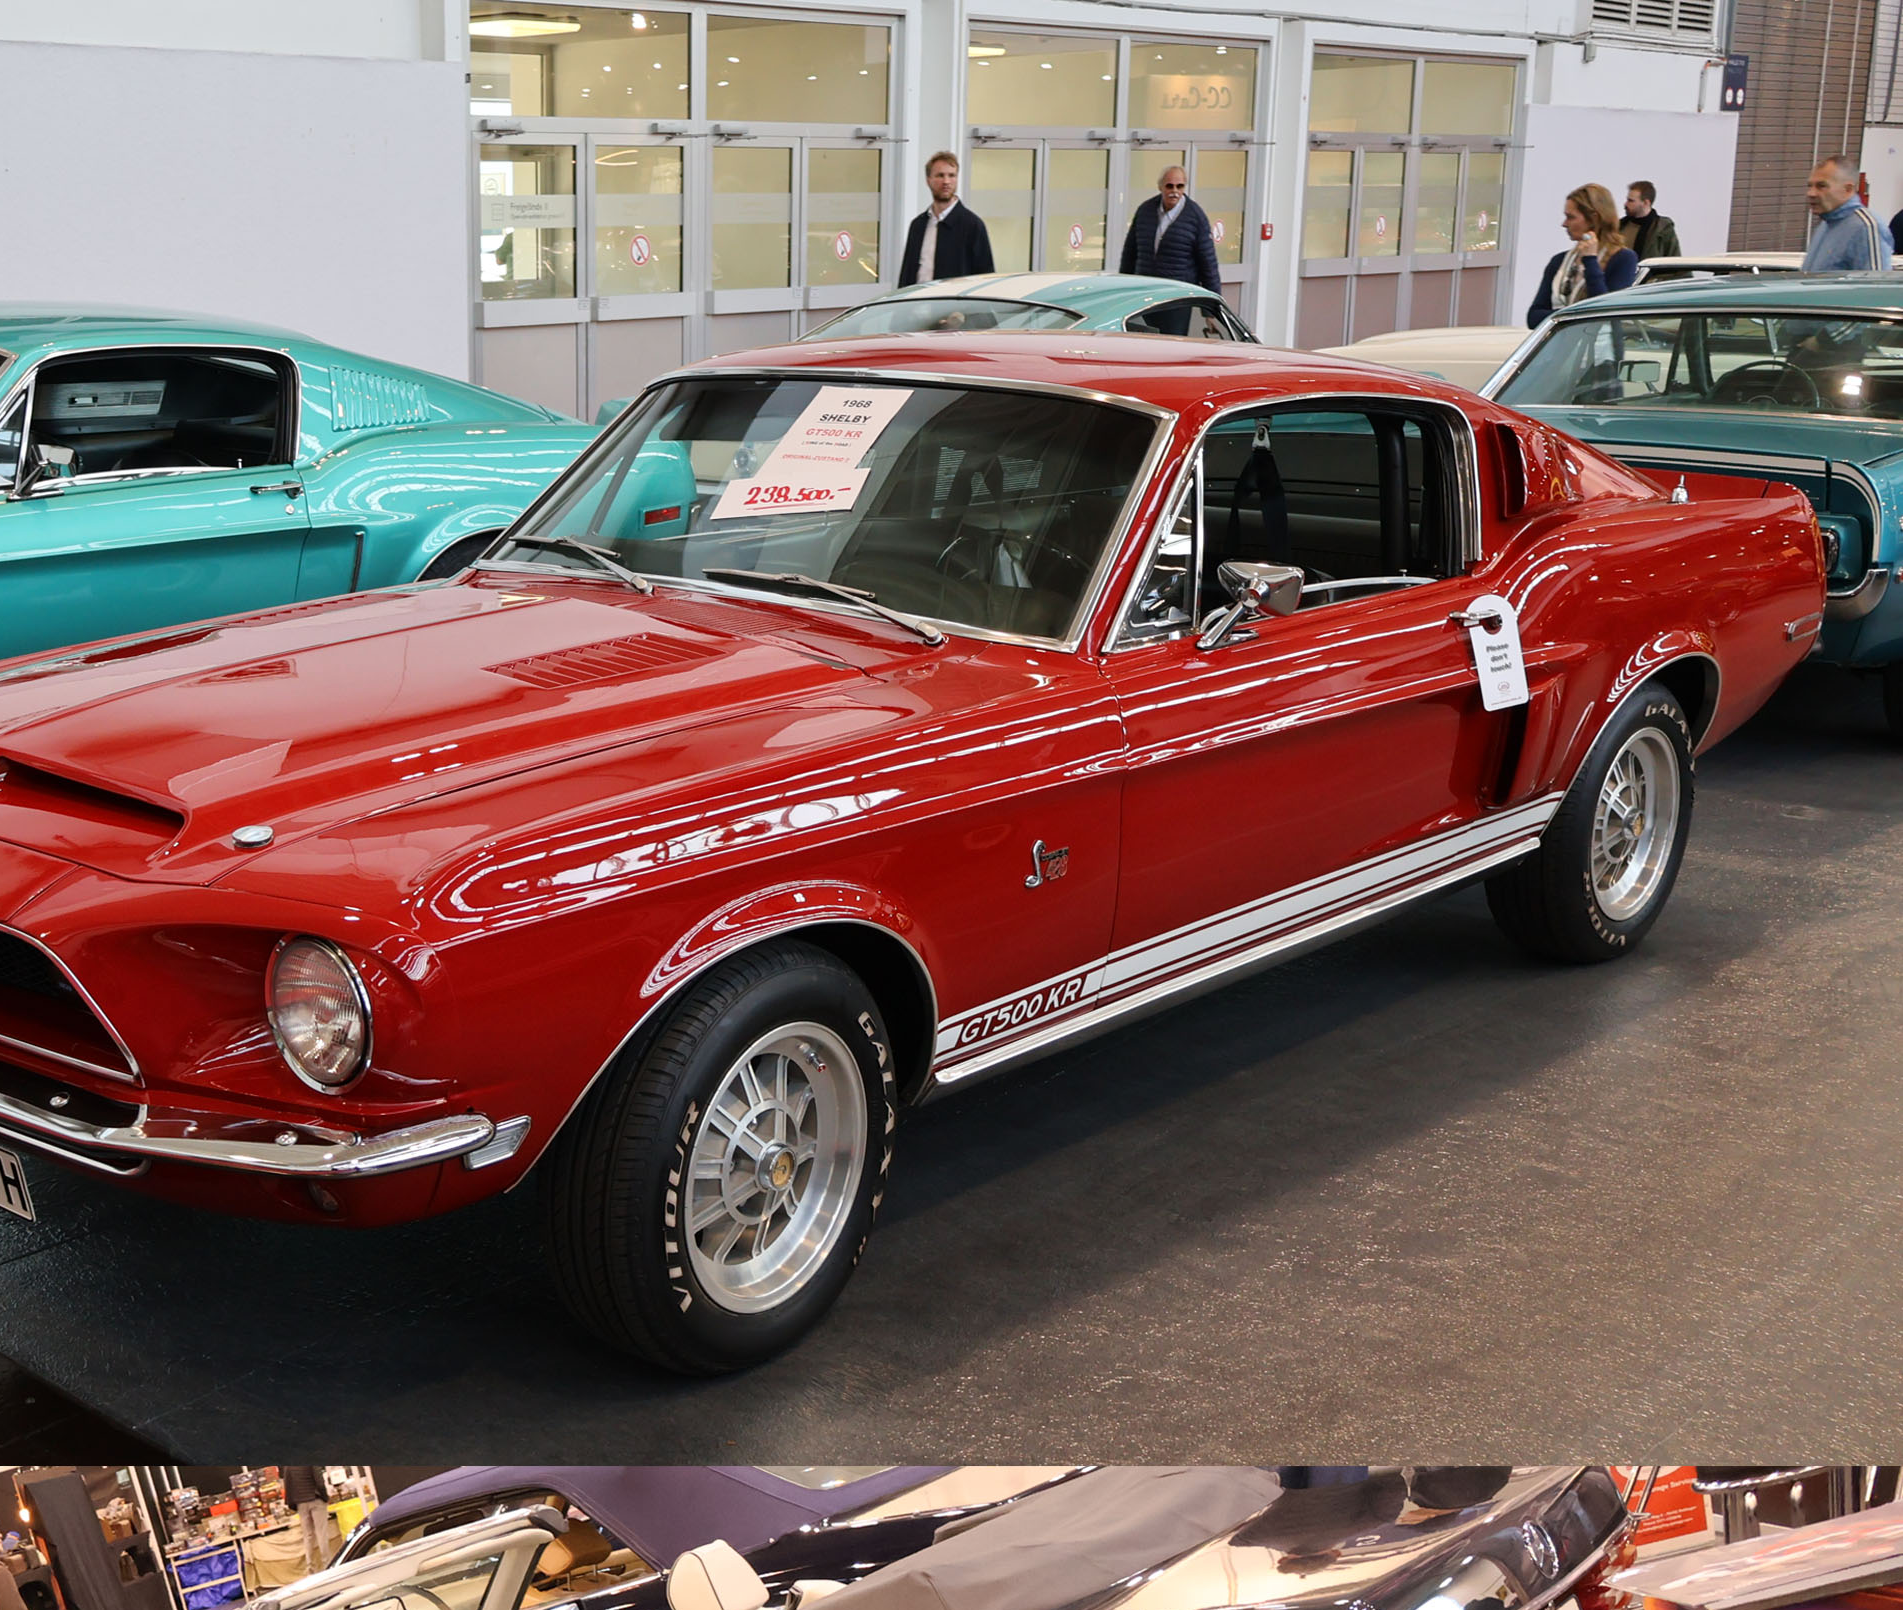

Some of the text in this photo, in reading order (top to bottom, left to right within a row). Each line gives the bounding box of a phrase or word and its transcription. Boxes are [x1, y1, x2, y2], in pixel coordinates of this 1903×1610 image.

[819, 414, 871, 423] SHELBY
[841, 399, 873, 408] 1968
[805, 428, 863, 438] GT500 KR
[961, 977, 1084, 1044] GT500 KR
[857, 1011, 896, 1224] GALAXY
[665, 1100, 700, 1314] VITOUR
